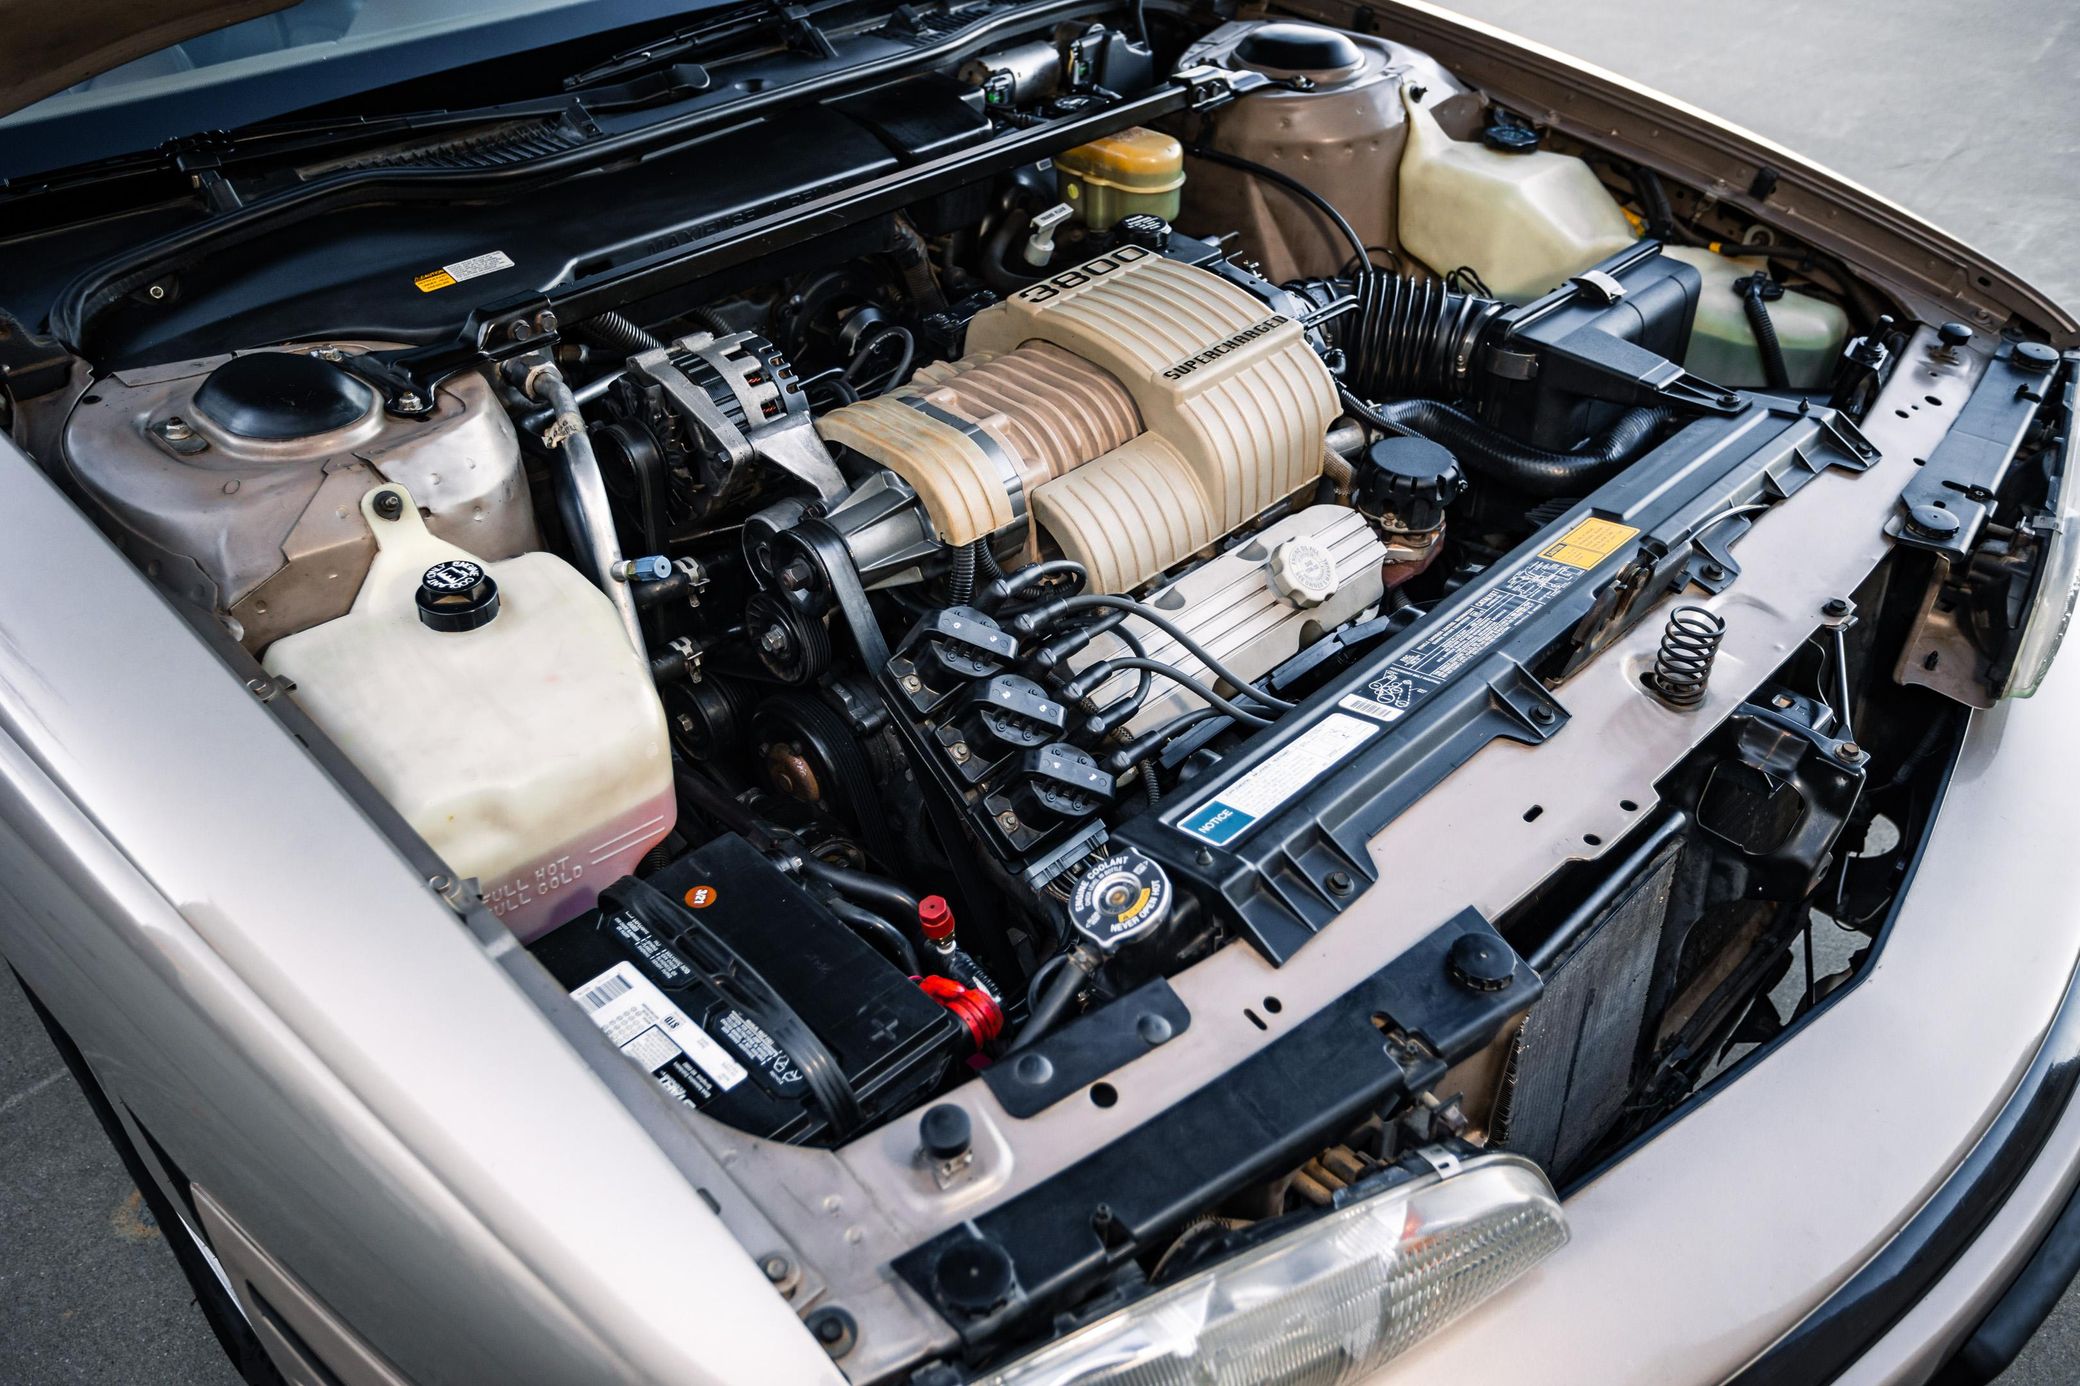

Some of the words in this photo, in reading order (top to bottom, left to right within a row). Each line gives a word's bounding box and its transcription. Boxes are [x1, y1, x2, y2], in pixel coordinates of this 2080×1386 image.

[1019, 246, 1150, 303] 3800
[1163, 315, 1289, 380] SUPERCHARGED
[426, 564, 446, 579] ONLY
[452, 562, 480, 576] ENGINE
[426, 577, 474, 589] COOLANT
[1198, 808, 1234, 834] NOTICE
[534, 856, 570, 879] HOT
[488, 893, 532, 917] ULL
[538, 865, 584, 895] COLD
[1075, 880, 1089, 912] ENGINE
[1087, 856, 1128, 880] COOLANT
[1110, 916, 1140, 932] NEVER
[1139, 896, 1158, 918] OPEN
[1151, 880, 1160, 896] HOT
[662, 1016, 680, 1028] STD
